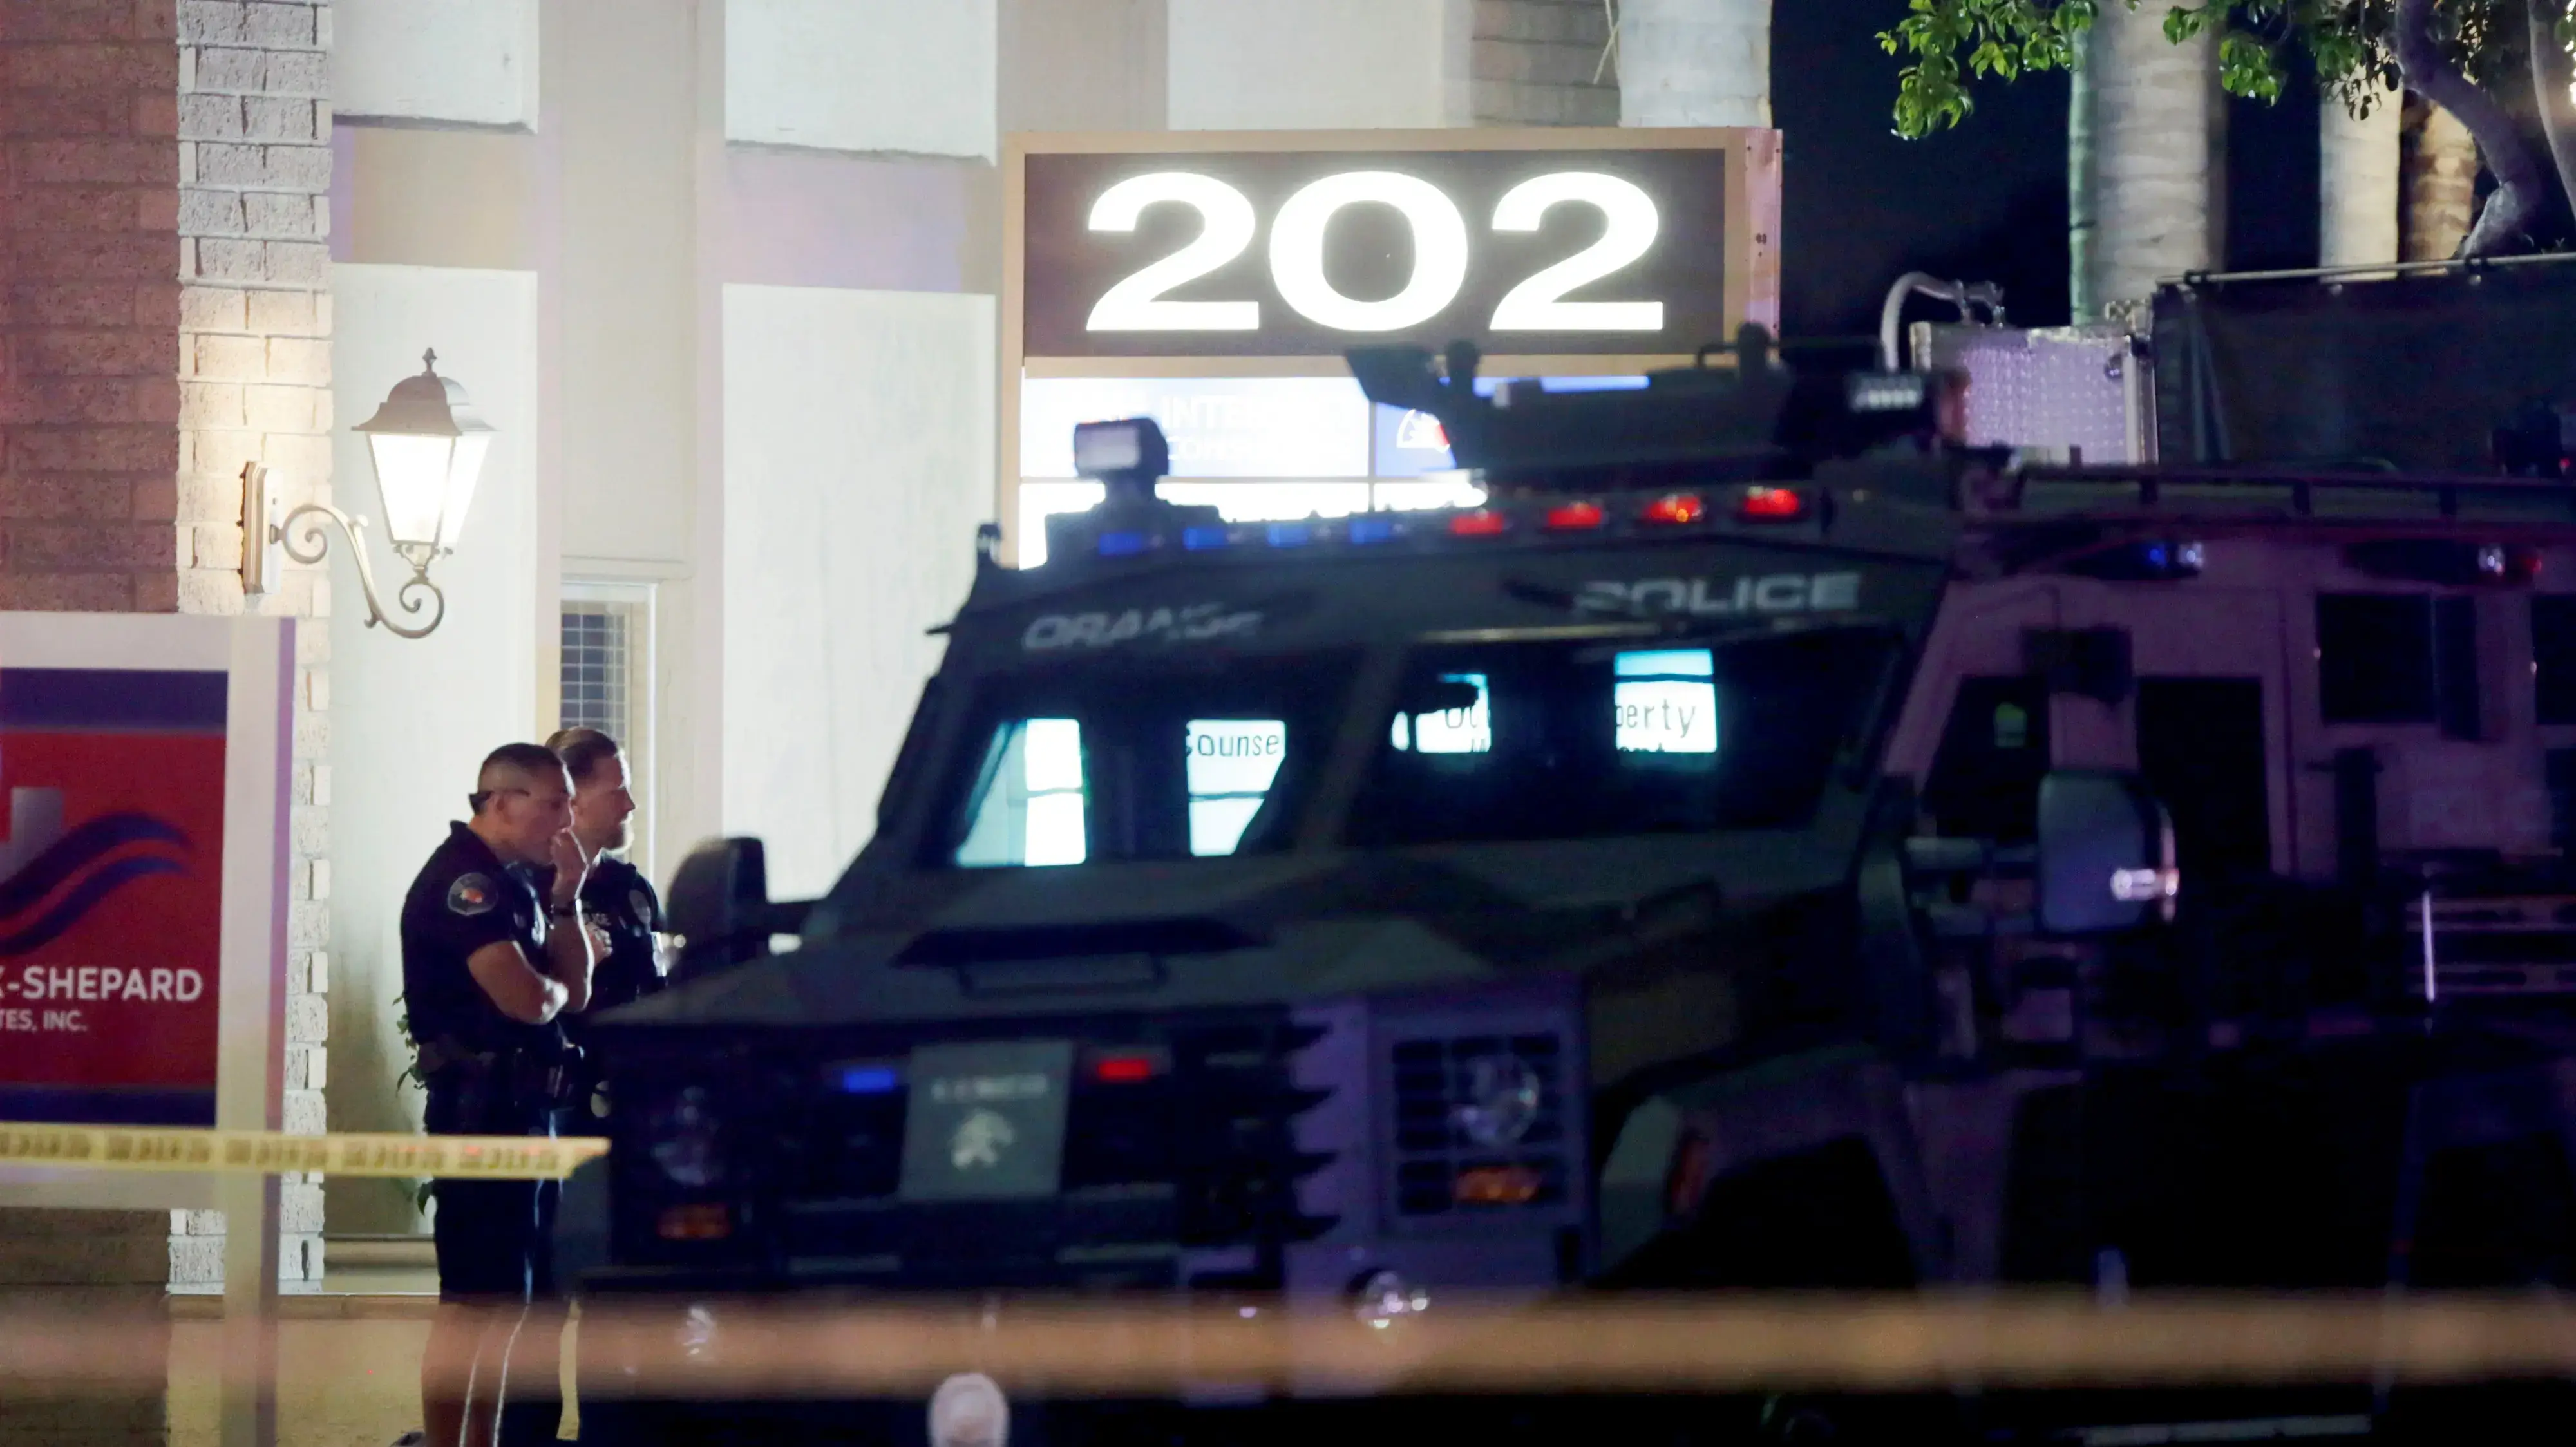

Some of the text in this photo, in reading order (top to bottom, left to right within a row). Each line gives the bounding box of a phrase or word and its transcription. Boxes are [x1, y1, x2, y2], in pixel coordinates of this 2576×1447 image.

[1086, 171, 1664, 331] 202
[1186, 728, 1280, 757] ounse
[0, 965, 203, 1001] -SHEPARD
[43, 1010, 88, 1032] INC.
